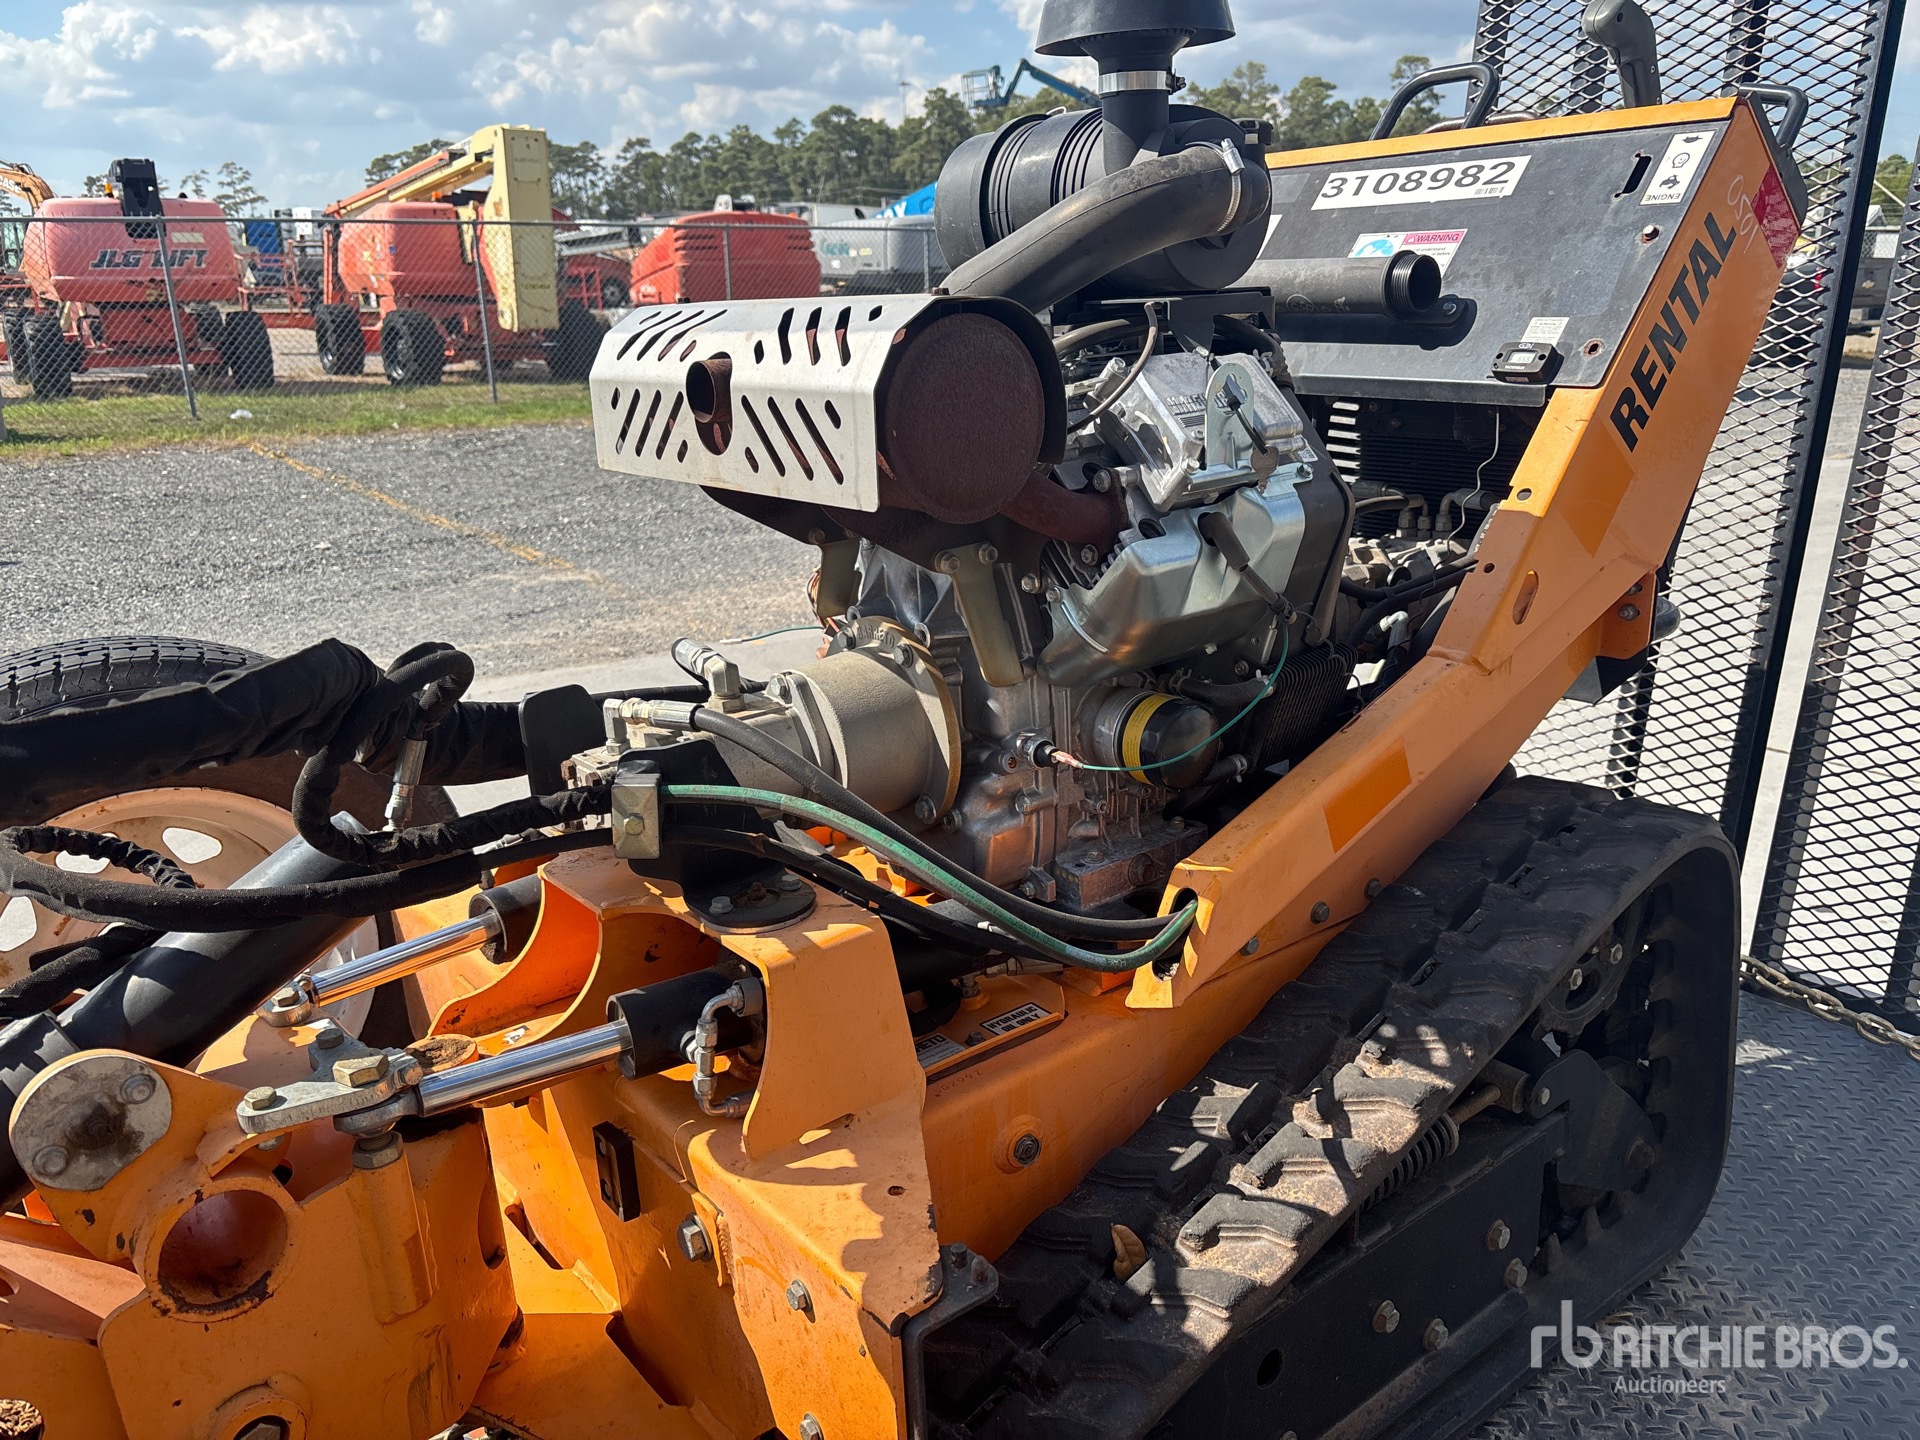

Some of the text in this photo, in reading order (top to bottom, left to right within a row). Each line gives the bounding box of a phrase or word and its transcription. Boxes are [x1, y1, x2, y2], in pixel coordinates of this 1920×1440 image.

[1321, 161, 1516, 199] 3108982
[1645, 192, 1682, 201] ENGINE
[1416, 233, 1460, 242] WARNING
[89, 248, 208, 269] JLG LIFT
[1609, 212, 1738, 453] RENTAL
[987, 1005, 1038, 1029] HYDRAULIC
[1001, 1013, 1041, 1033] OIL ONLY
